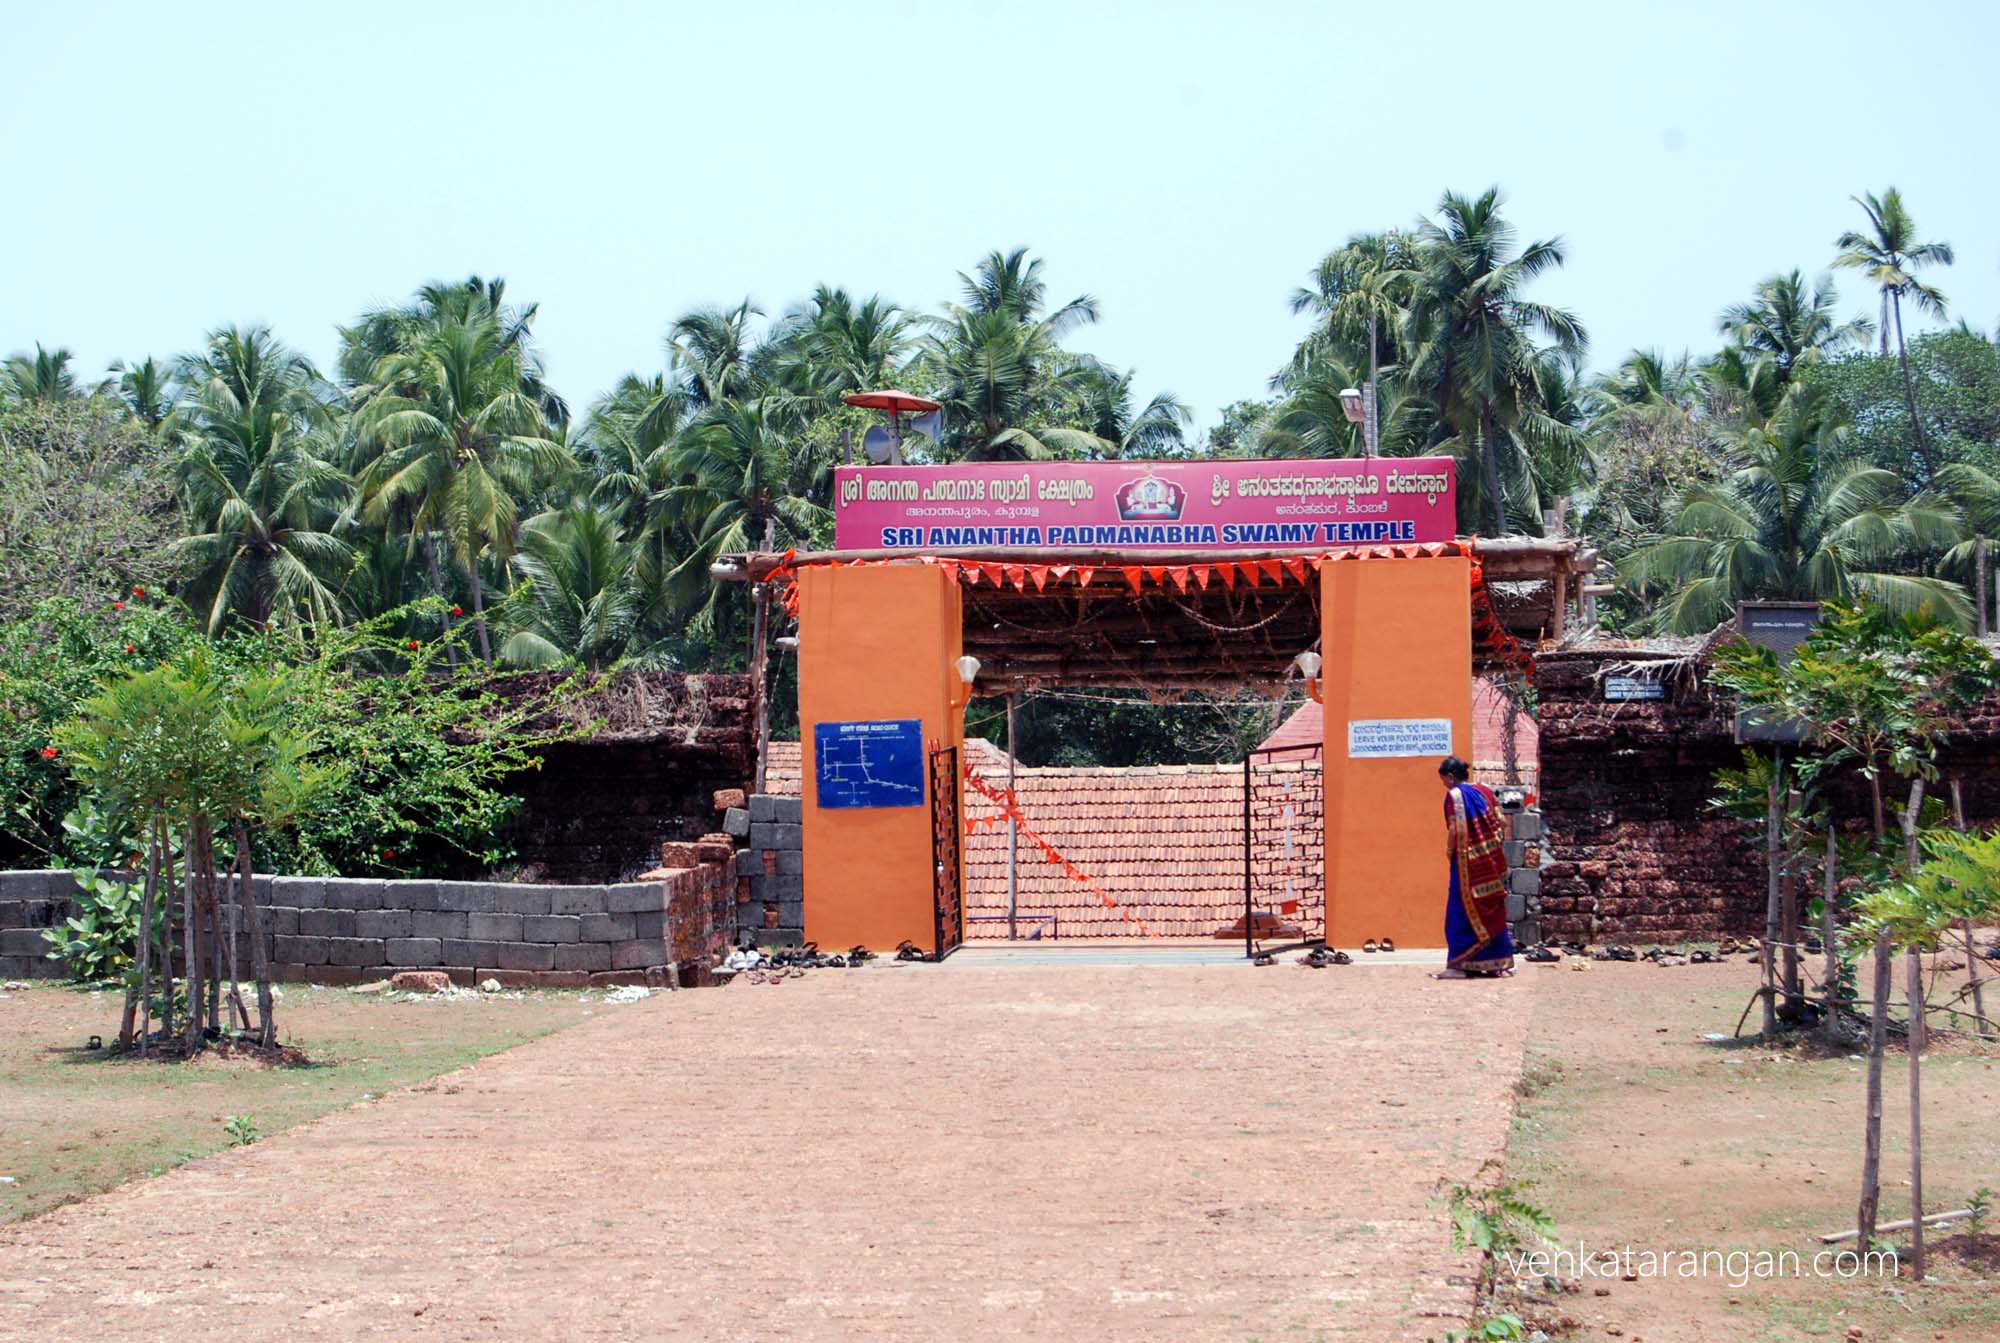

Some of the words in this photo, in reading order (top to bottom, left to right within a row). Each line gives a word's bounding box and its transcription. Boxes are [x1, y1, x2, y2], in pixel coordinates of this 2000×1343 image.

[841, 473, 863, 507] ശ്രീ
[867, 478, 919, 501] അനന്ത
[1210, 474, 1230, 506] ಶ್ರೀ
[882, 527, 925, 547] SRI
[928, 526, 1043, 546] ANANTHA
[1047, 524, 1218, 546] PADMANABHA
[1222, 522, 1319, 543] SWAMY
[1323, 520, 1416, 542] TEMPLE
[1354, 735, 1375, 743] LEAVE
[1377, 734, 1394, 743] YOUR
